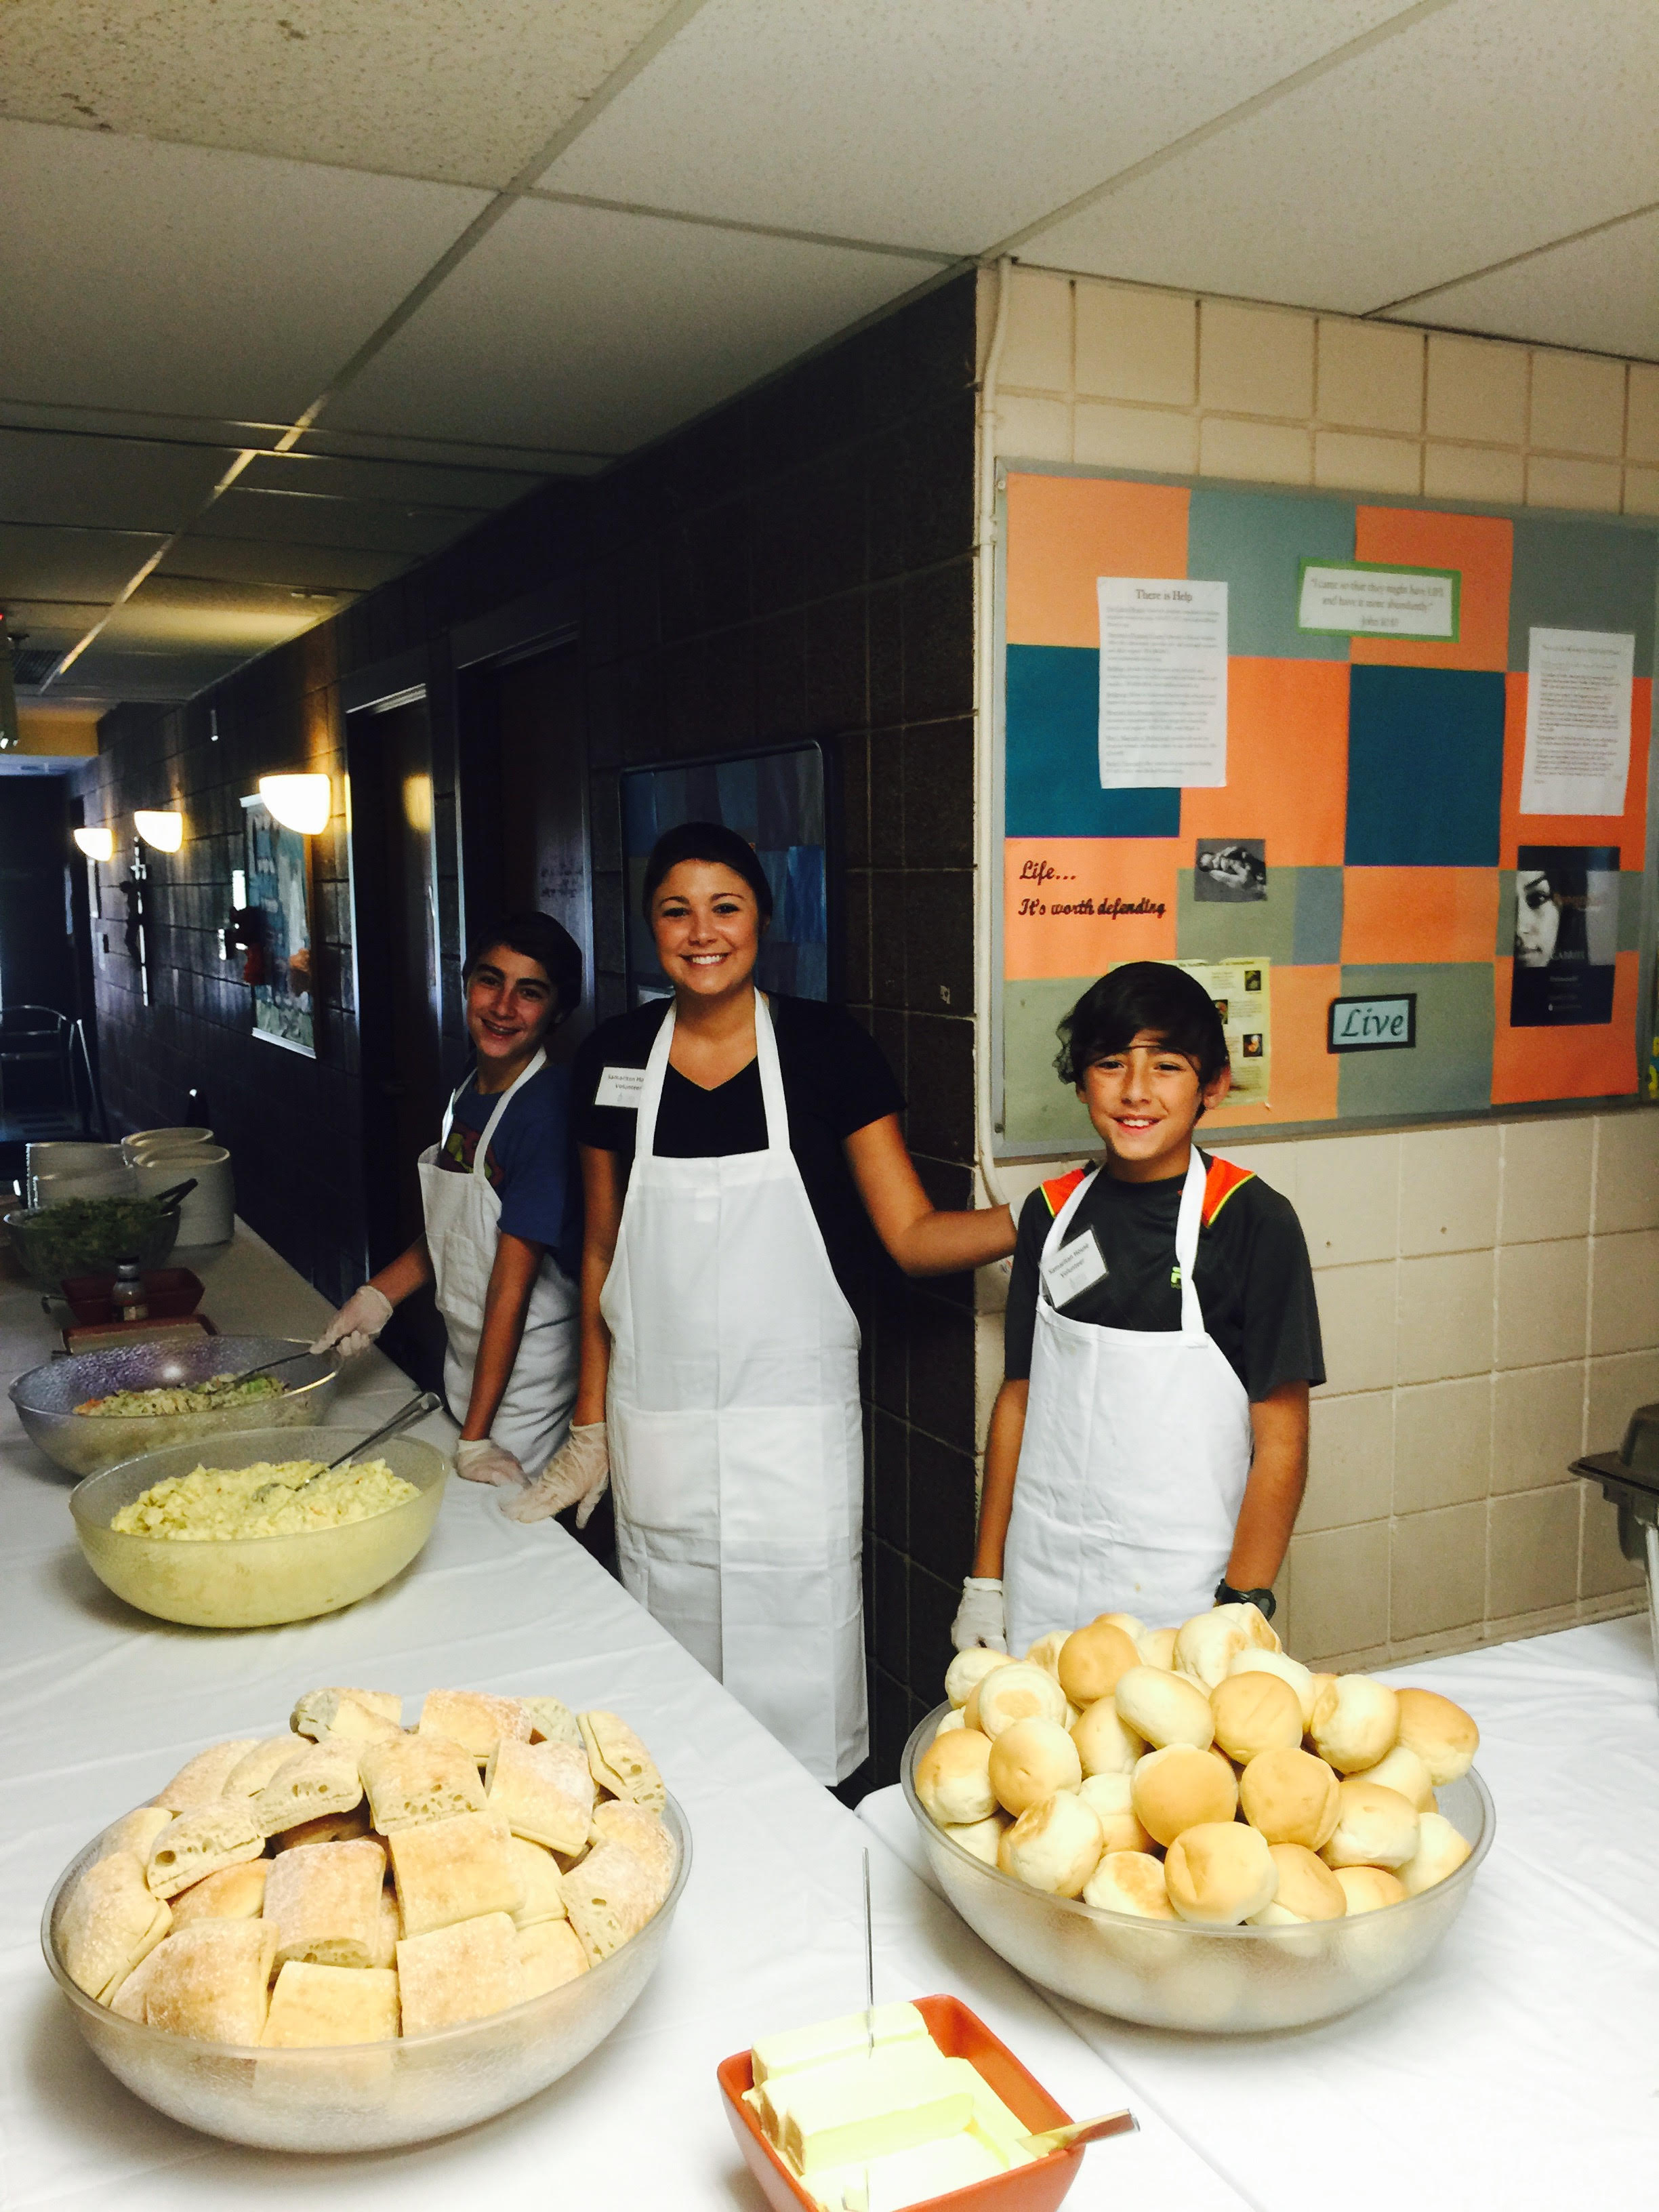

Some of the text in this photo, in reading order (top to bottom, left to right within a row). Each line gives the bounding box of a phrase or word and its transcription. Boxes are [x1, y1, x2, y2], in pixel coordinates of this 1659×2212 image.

[1136, 589, 1193, 603] There is Help
[1019, 860, 1076, 886] Life...
[1018, 897, 1166, 920] It's worth defending
[1340, 1008, 1404, 1037] Live
[1048, 1243, 1089, 1274] Samaritan House
[1060, 1258, 1084, 1278] Volunteer
